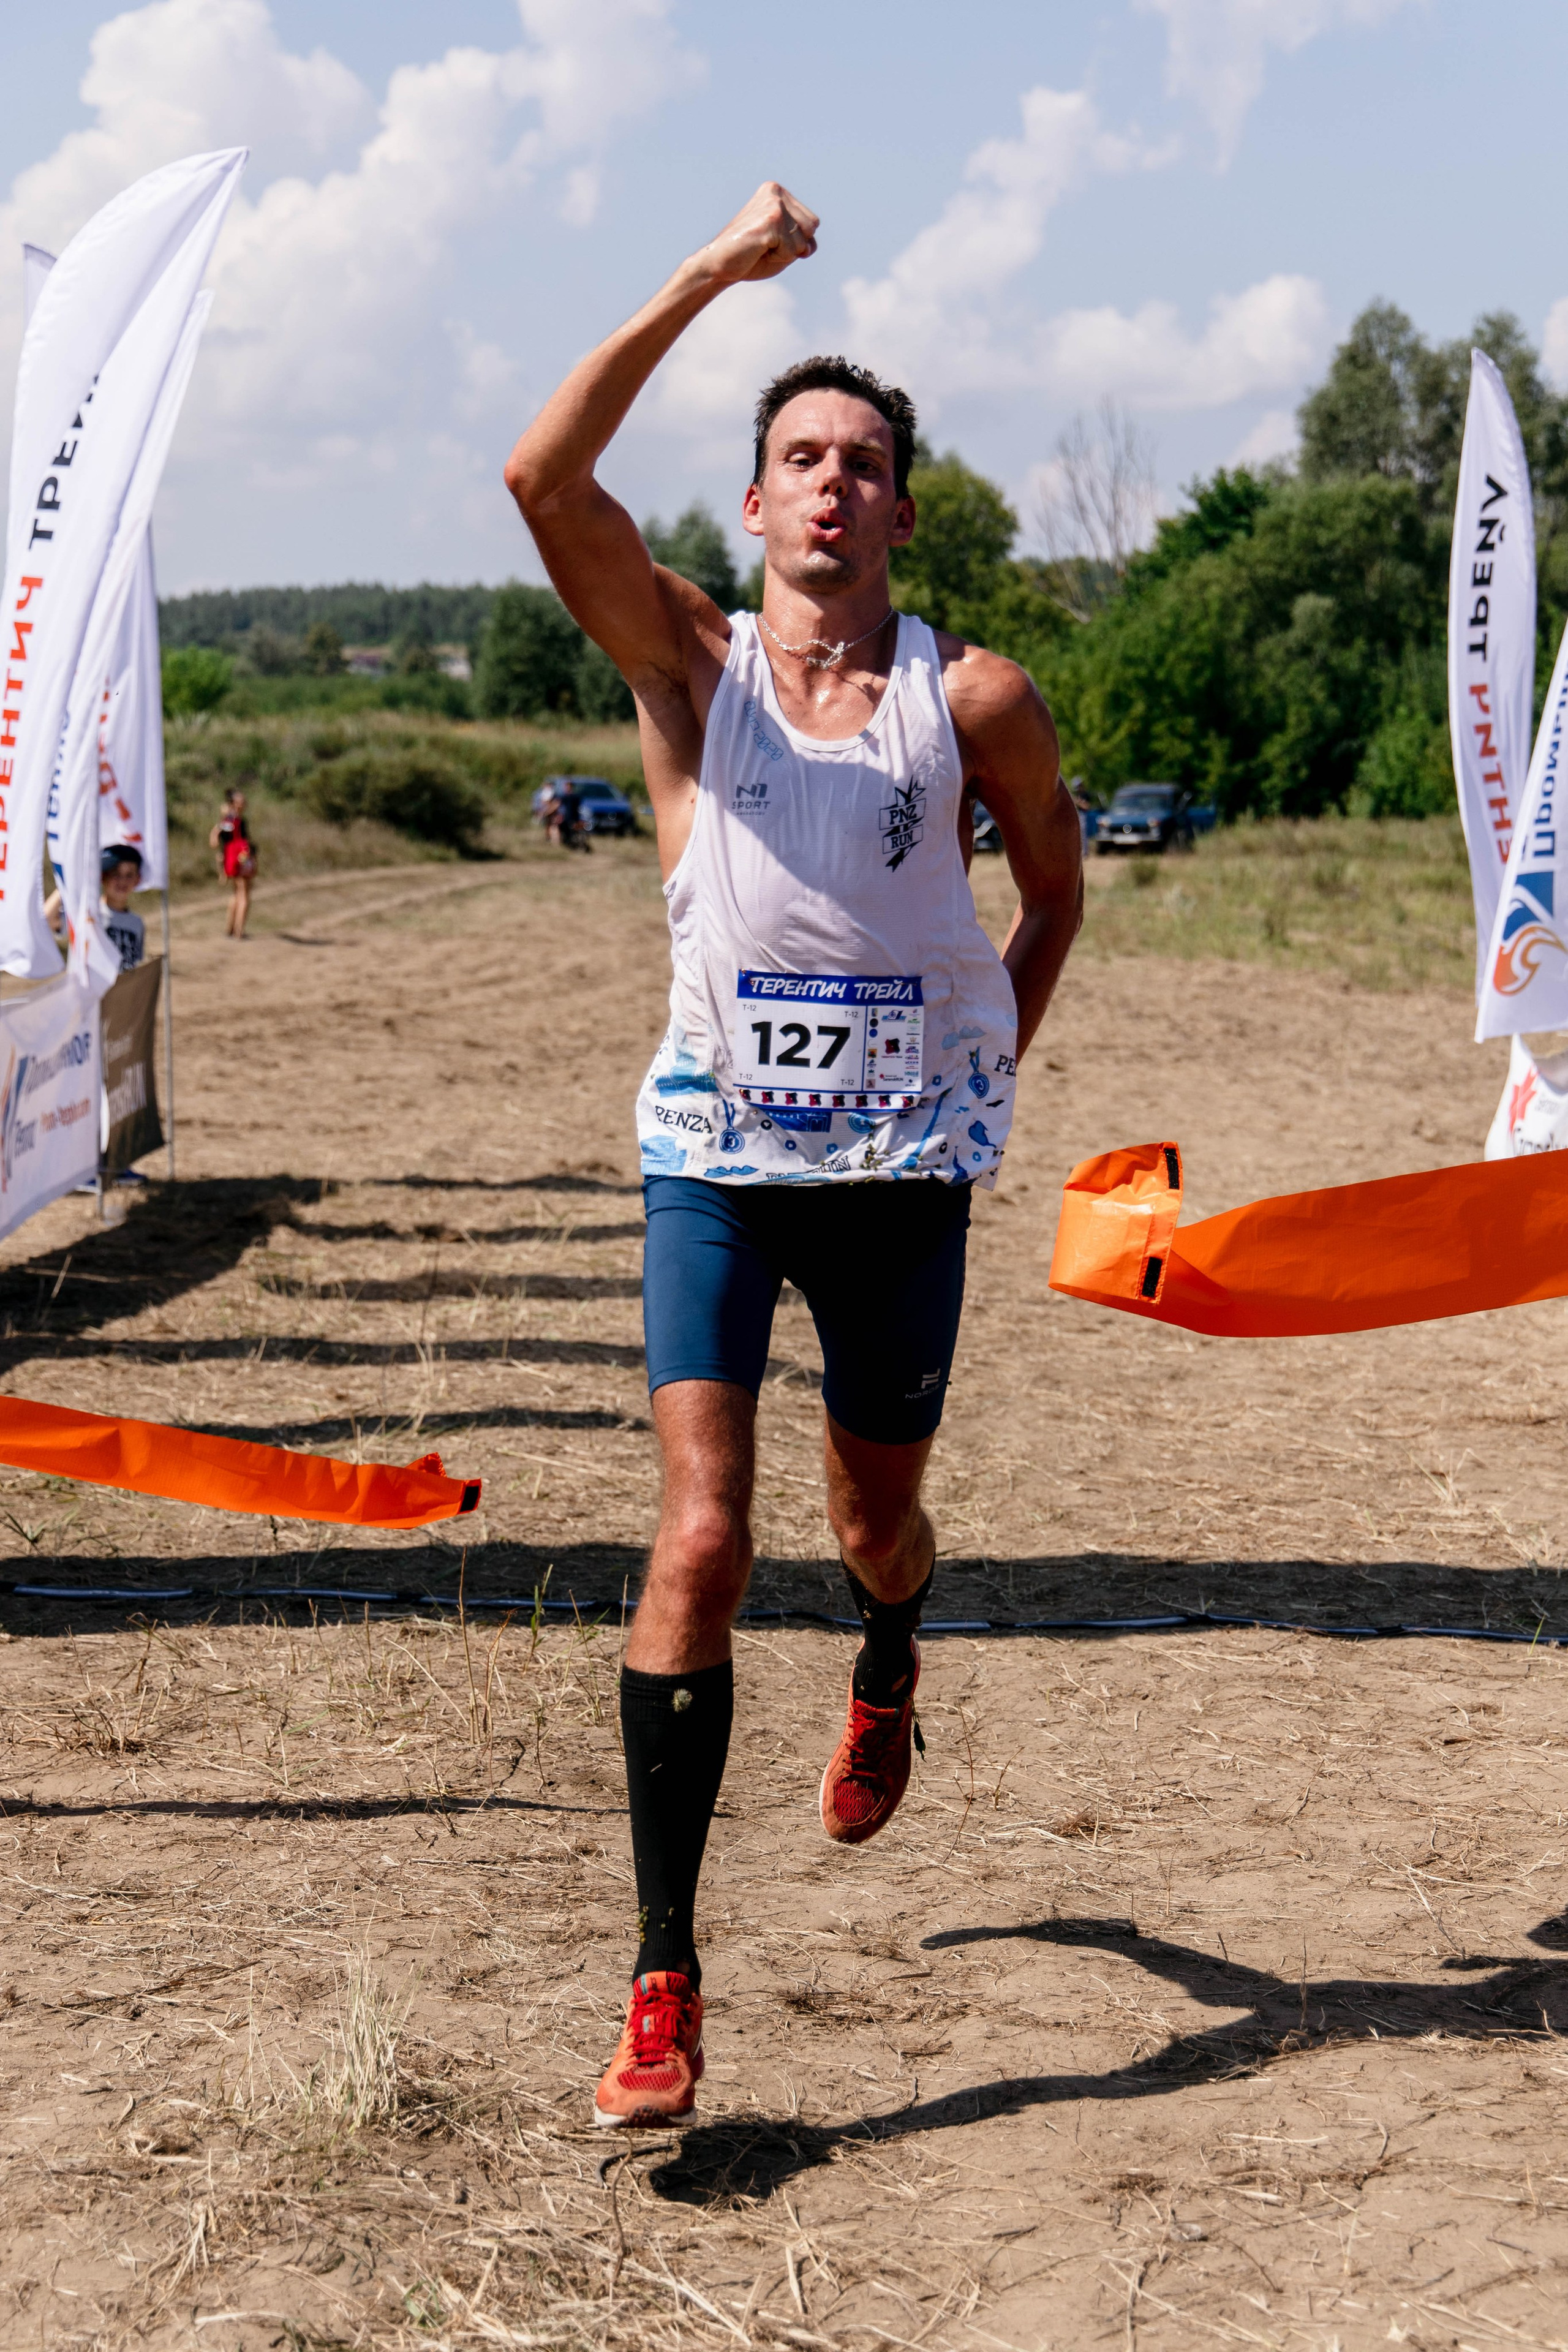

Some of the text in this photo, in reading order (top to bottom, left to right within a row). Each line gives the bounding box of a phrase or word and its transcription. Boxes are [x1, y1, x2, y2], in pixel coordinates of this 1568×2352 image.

[753, 731, 784, 761] 2020
[889, 804, 918, 825] PNZ
[891, 830, 913, 849] RUN
[752, 977, 913, 1000] ТЕРЕНТИЧ ТРЕЙЛ
[751, 1021, 851, 1069] 127
[655, 1105, 712, 1134] PENZA
[726, 1136, 735, 1148] 3
